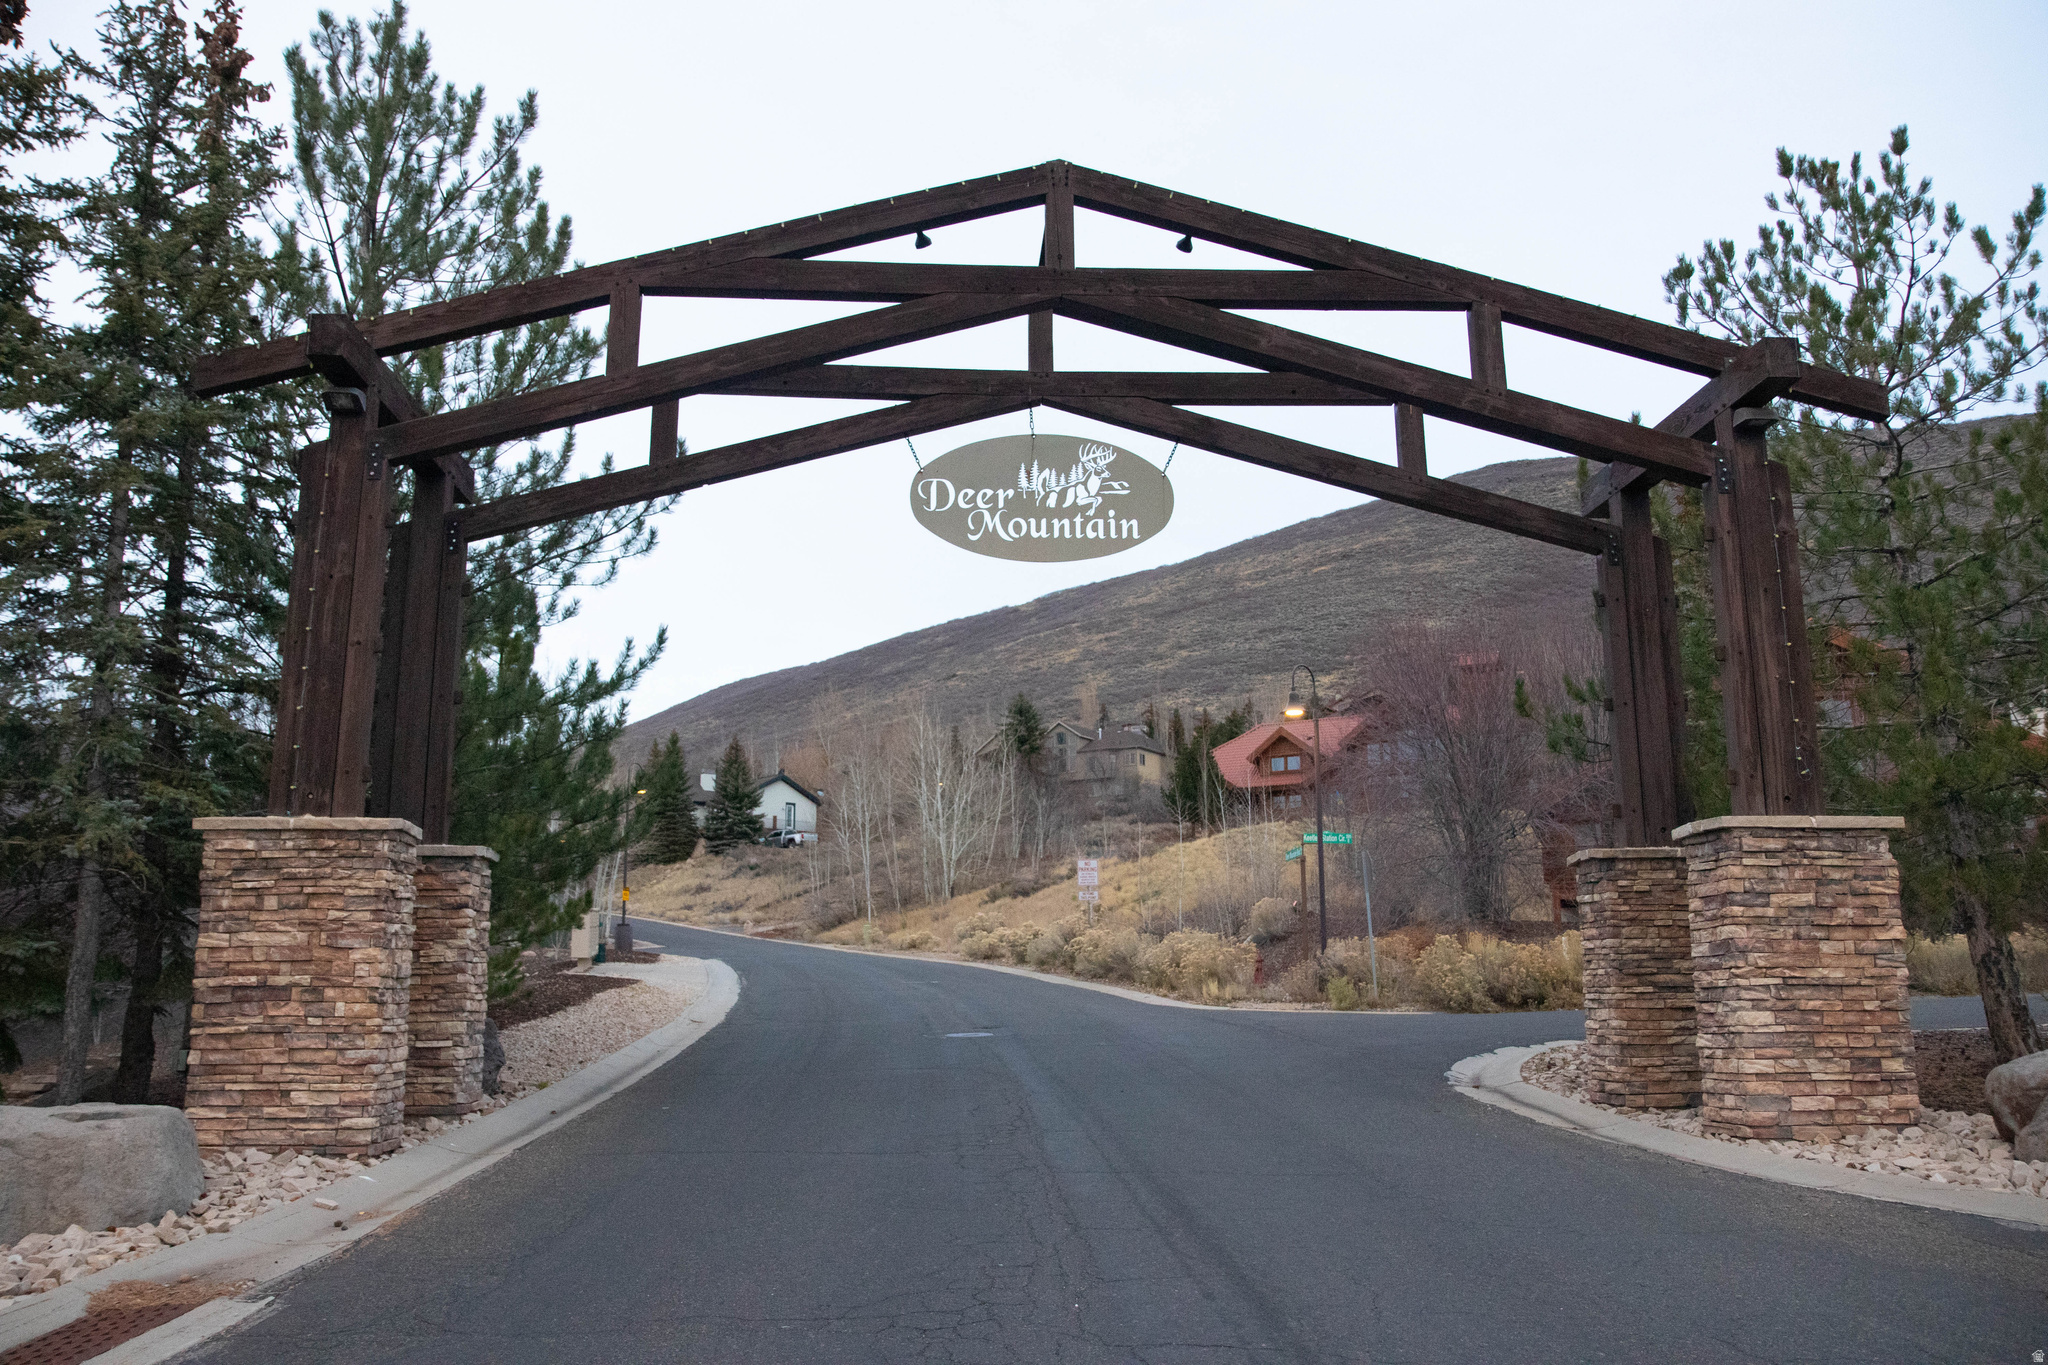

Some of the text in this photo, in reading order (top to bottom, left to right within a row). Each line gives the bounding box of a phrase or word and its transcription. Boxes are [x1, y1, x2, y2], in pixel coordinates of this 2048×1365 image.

[917, 478, 1015, 512] Deer
[967, 509, 1141, 542] Mountain
[1303, 833, 1320, 842] Keetle
